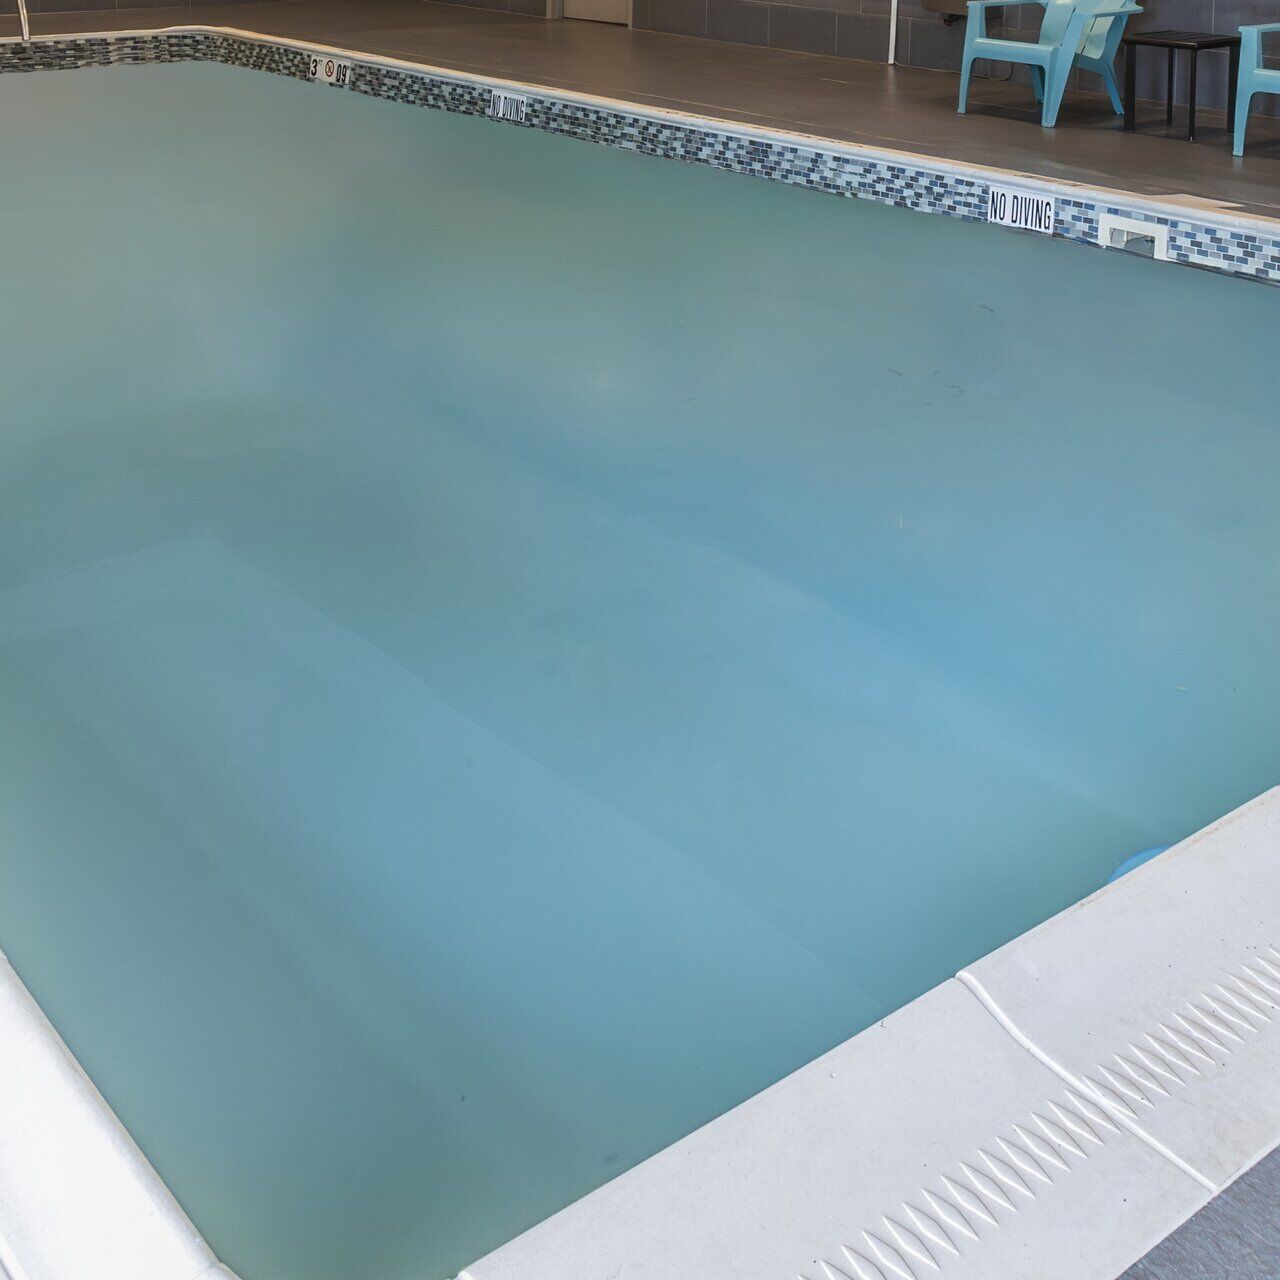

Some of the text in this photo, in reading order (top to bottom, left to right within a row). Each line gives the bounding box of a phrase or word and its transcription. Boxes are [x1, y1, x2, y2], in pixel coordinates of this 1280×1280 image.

[311, 59, 318, 76] 3
[492, 93, 524, 121] NO DIVING
[990, 190, 1051, 230] NO DIVING
